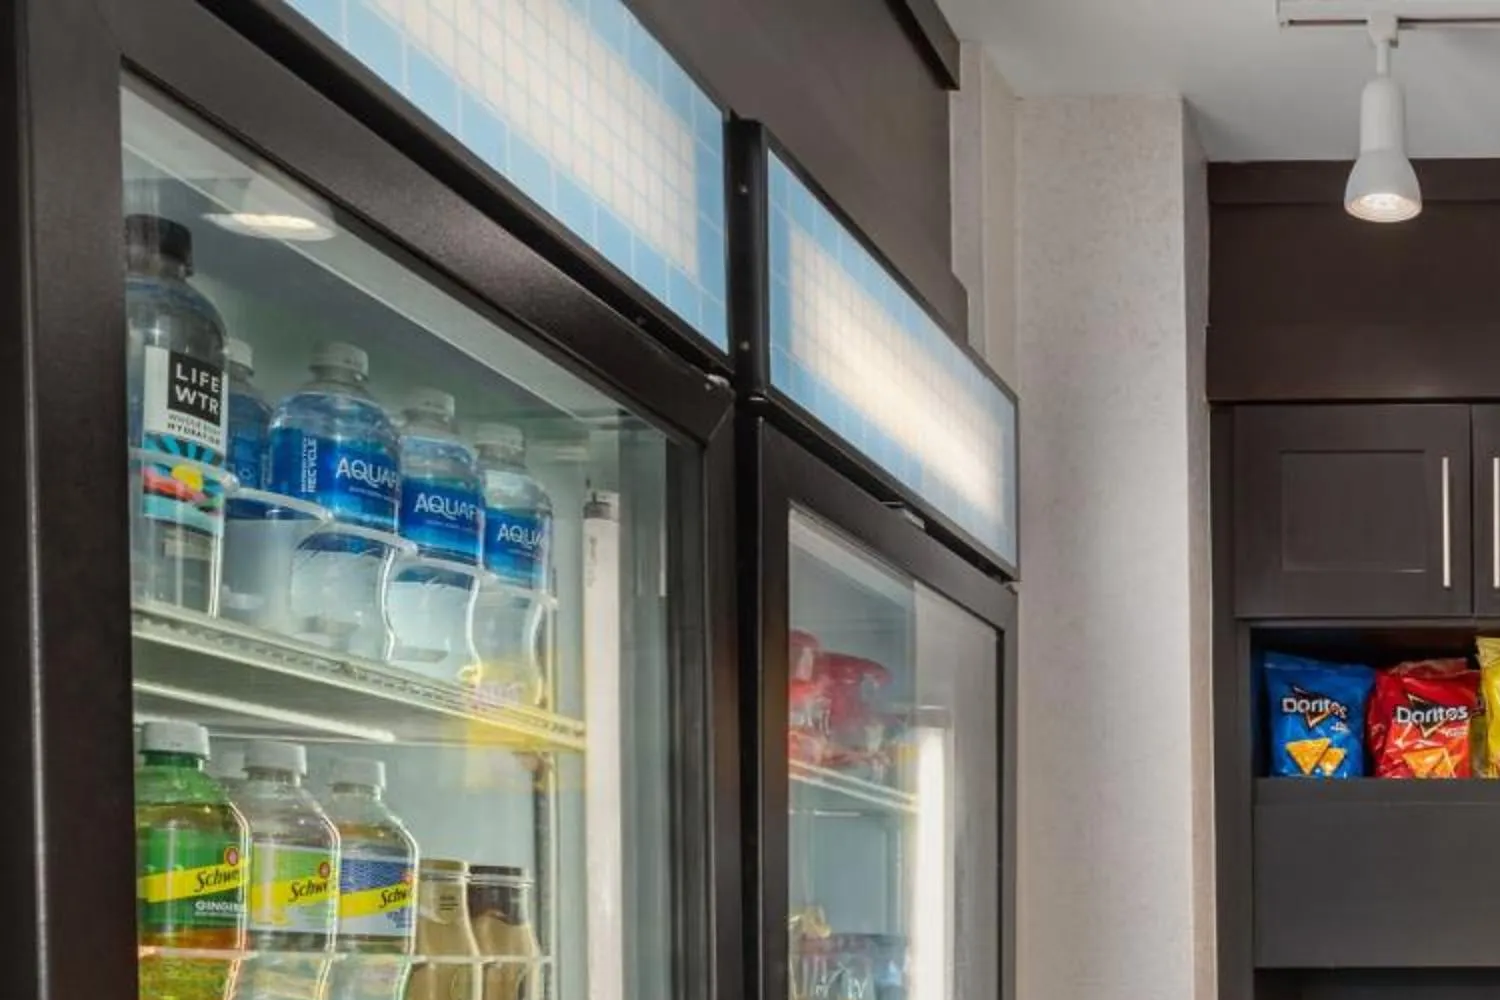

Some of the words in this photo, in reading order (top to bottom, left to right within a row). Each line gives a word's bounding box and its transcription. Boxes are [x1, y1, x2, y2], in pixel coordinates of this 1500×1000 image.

[175, 361, 221, 393] LIFE
[174, 383, 220, 415] WTR
[1282, 696, 1348, 719] Doritos
[1396, 705, 1469, 724] Doritos
